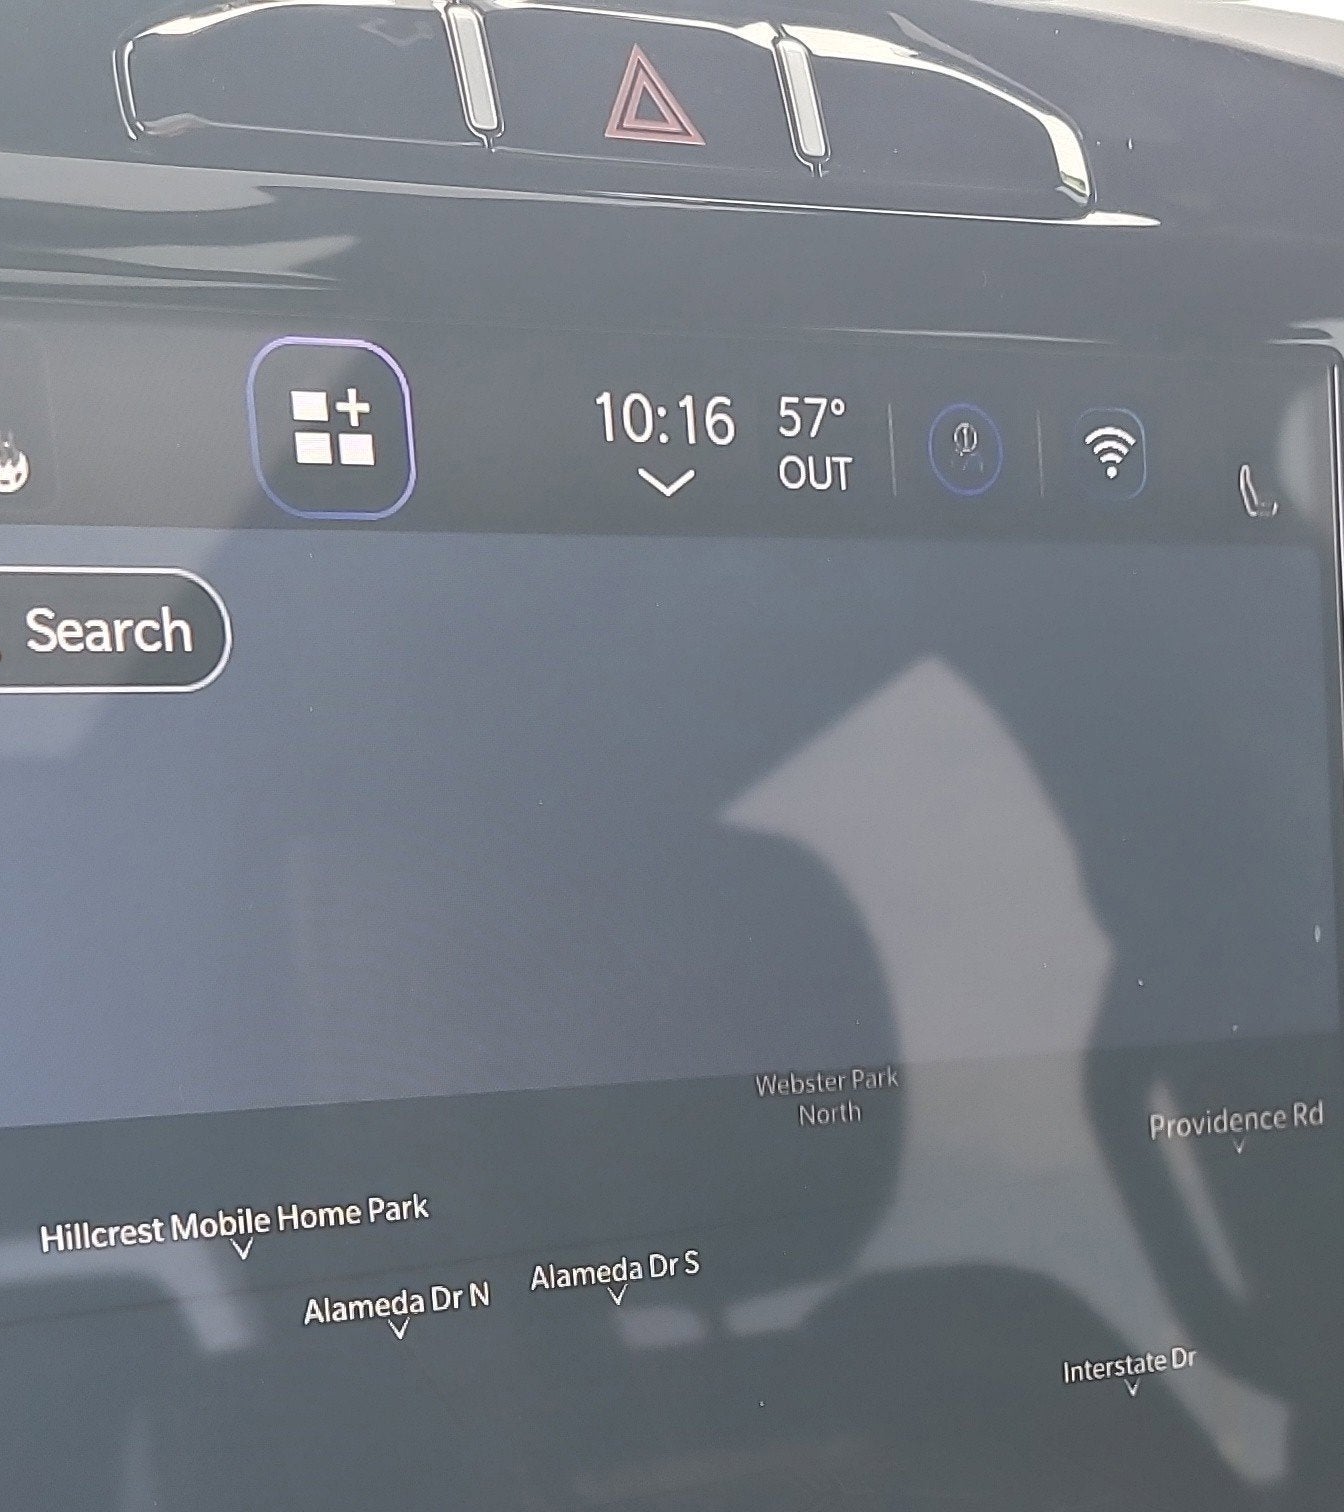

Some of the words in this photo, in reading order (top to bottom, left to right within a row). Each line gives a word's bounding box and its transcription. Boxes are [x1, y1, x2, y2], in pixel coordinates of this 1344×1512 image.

[595, 391, 736, 446] 10:16
[778, 454, 854, 491] OUT
[26, 606, 194, 654] Search
[755, 1071, 847, 1098] Webster
[851, 1065, 899, 1092] Park
[798, 1101, 863, 1127] North
[1150, 1107, 1288, 1141] Providence
[1293, 1100, 1324, 1127] Rd
[40, 1216, 166, 1253] Hillcrest
[170, 1207, 271, 1242] Mobile
[276, 1202, 362, 1232] Home
[367, 1193, 430, 1224] Park
[530, 1261, 644, 1291] Alameda
[649, 1253, 681, 1279] Dr
[683, 1249, 701, 1275] S
[303, 1294, 426, 1326] Alameda
[430, 1286, 467, 1312] Dr
[469, 1282, 491, 1309] N
[1063, 1352, 1169, 1384] Interstate
[1171, 1348, 1197, 1371] Dr
